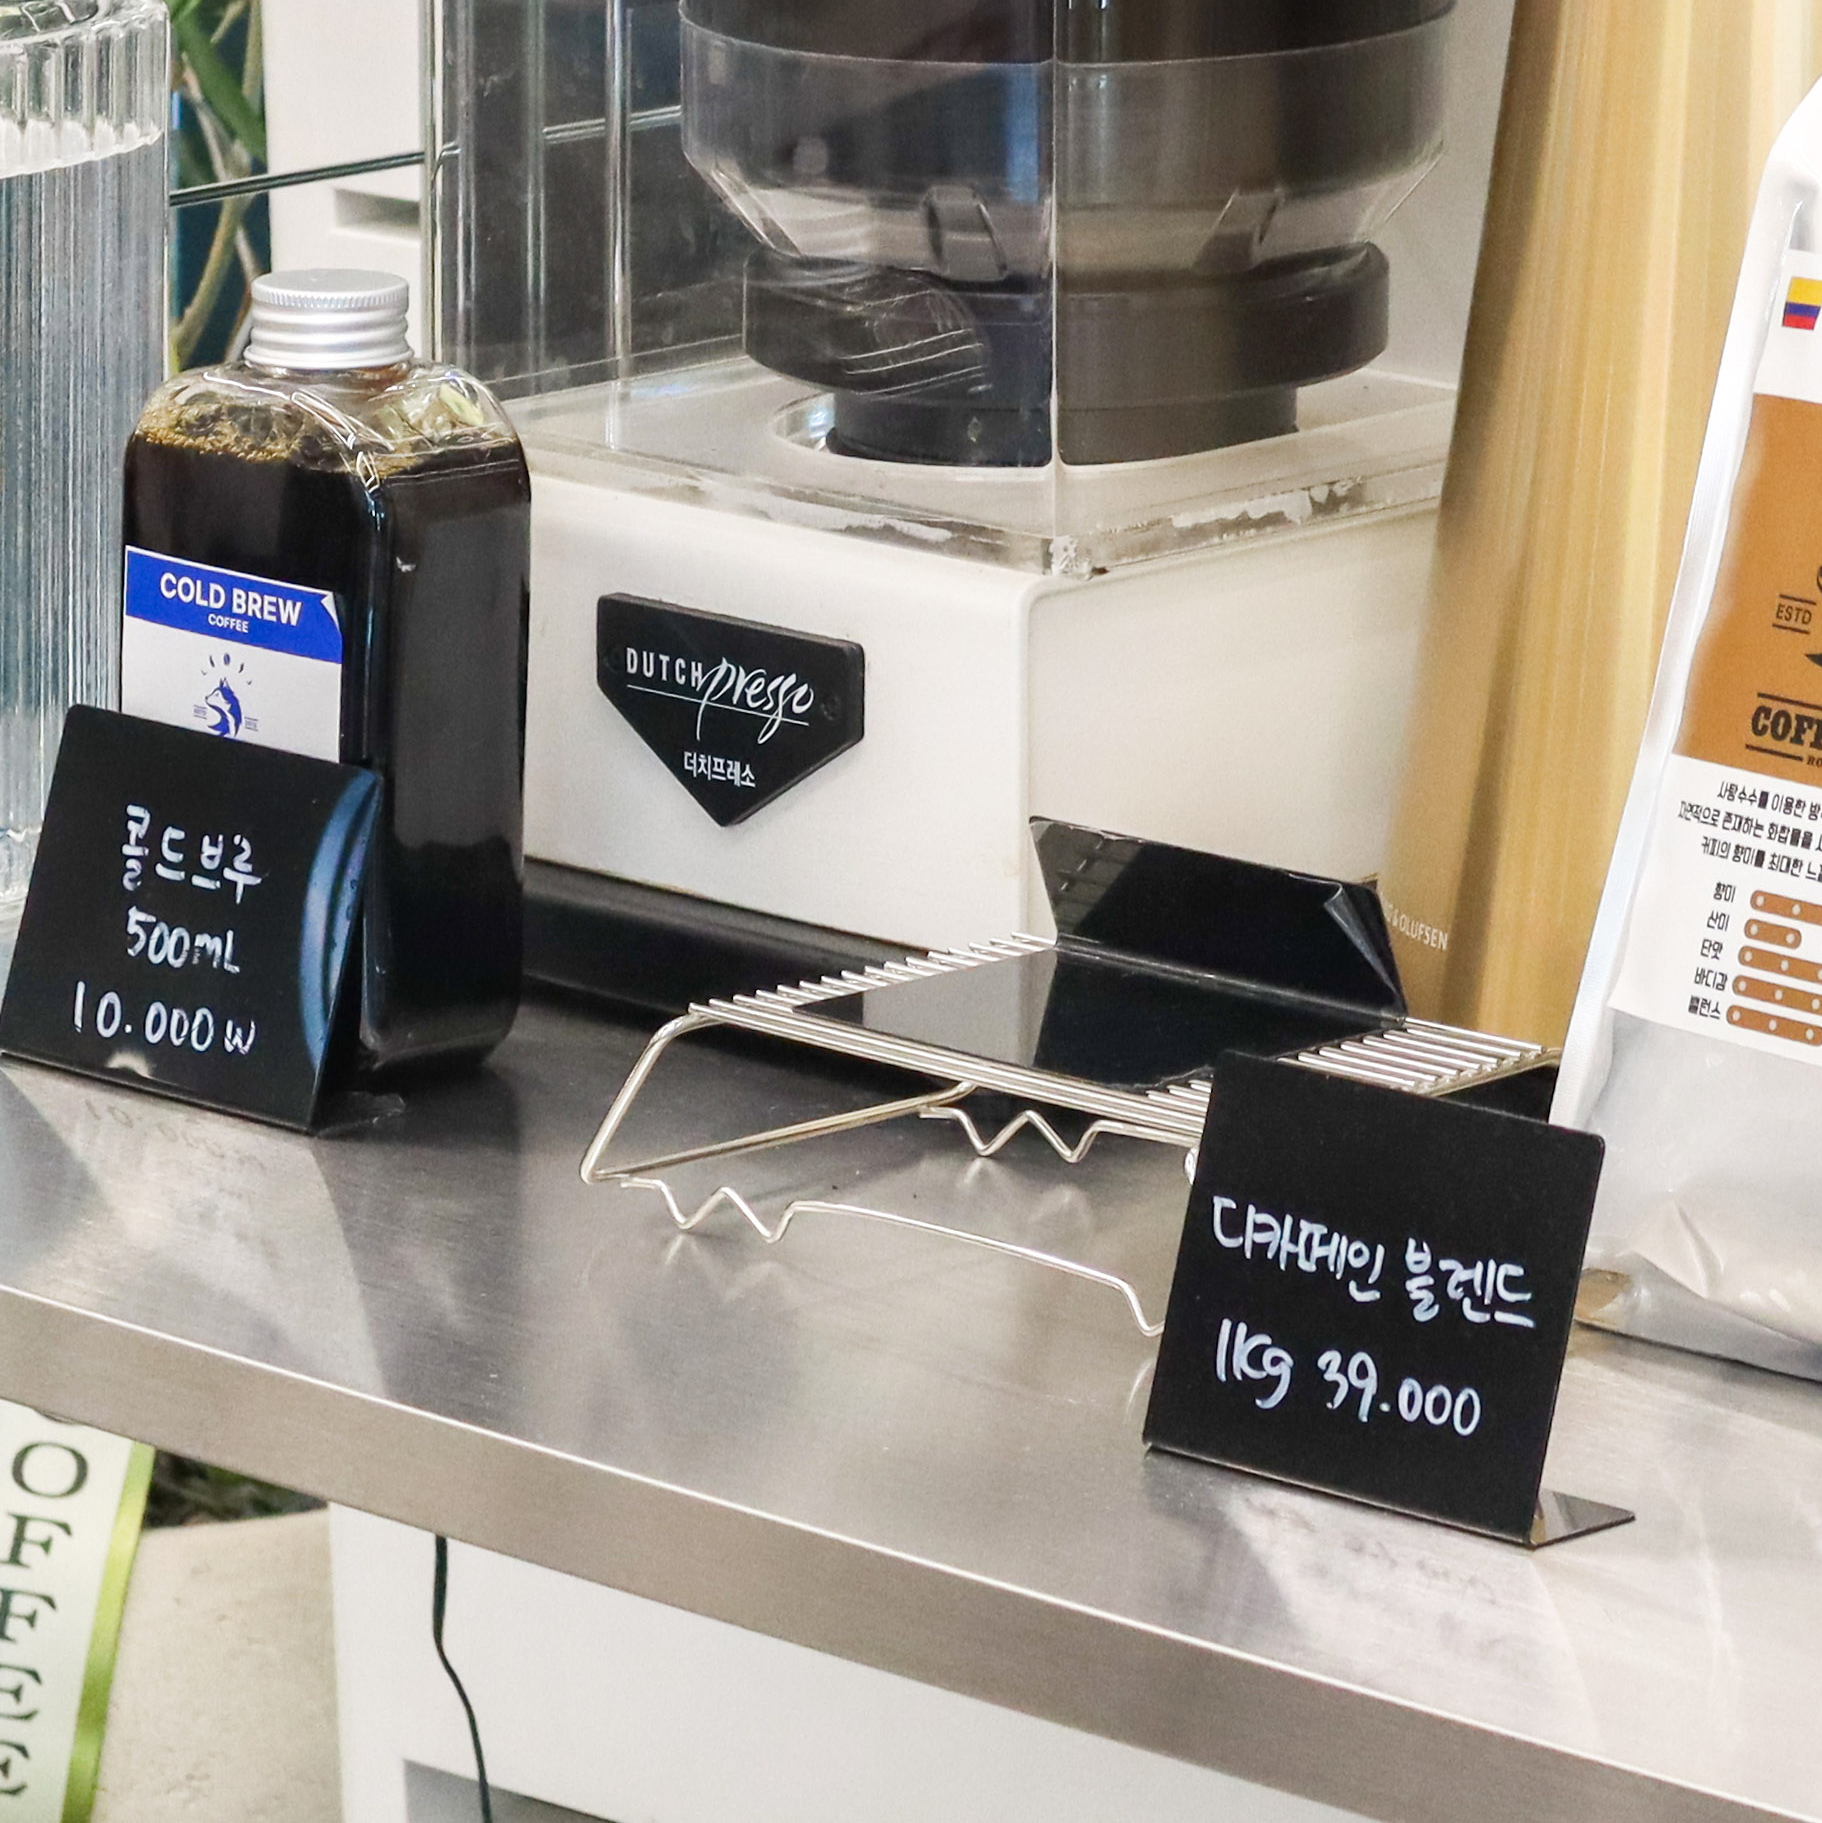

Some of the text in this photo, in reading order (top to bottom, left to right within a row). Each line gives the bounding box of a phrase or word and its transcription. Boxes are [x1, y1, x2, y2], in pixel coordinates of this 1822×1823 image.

[160, 572, 302, 626] COLD BREW
[208, 613, 249, 633] COFFEE
[1775, 603, 1813, 626] ESTD
[684, 751, 756, 787] 더치프레소
[1772, 793, 1807, 818] 이용한
[122, 804, 262, 904] 콜드브루
[1768, 852, 1803, 877] 최대한
[1713, 881, 1736, 902] 향미
[1400, 914, 1449, 951] OLUFSEN
[1706, 909, 1730, 931] 산미
[1700, 938, 1723, 961] 단맛
[1694, 966, 1727, 992] 바디감
[1688, 995, 1721, 1020] 밸런스
